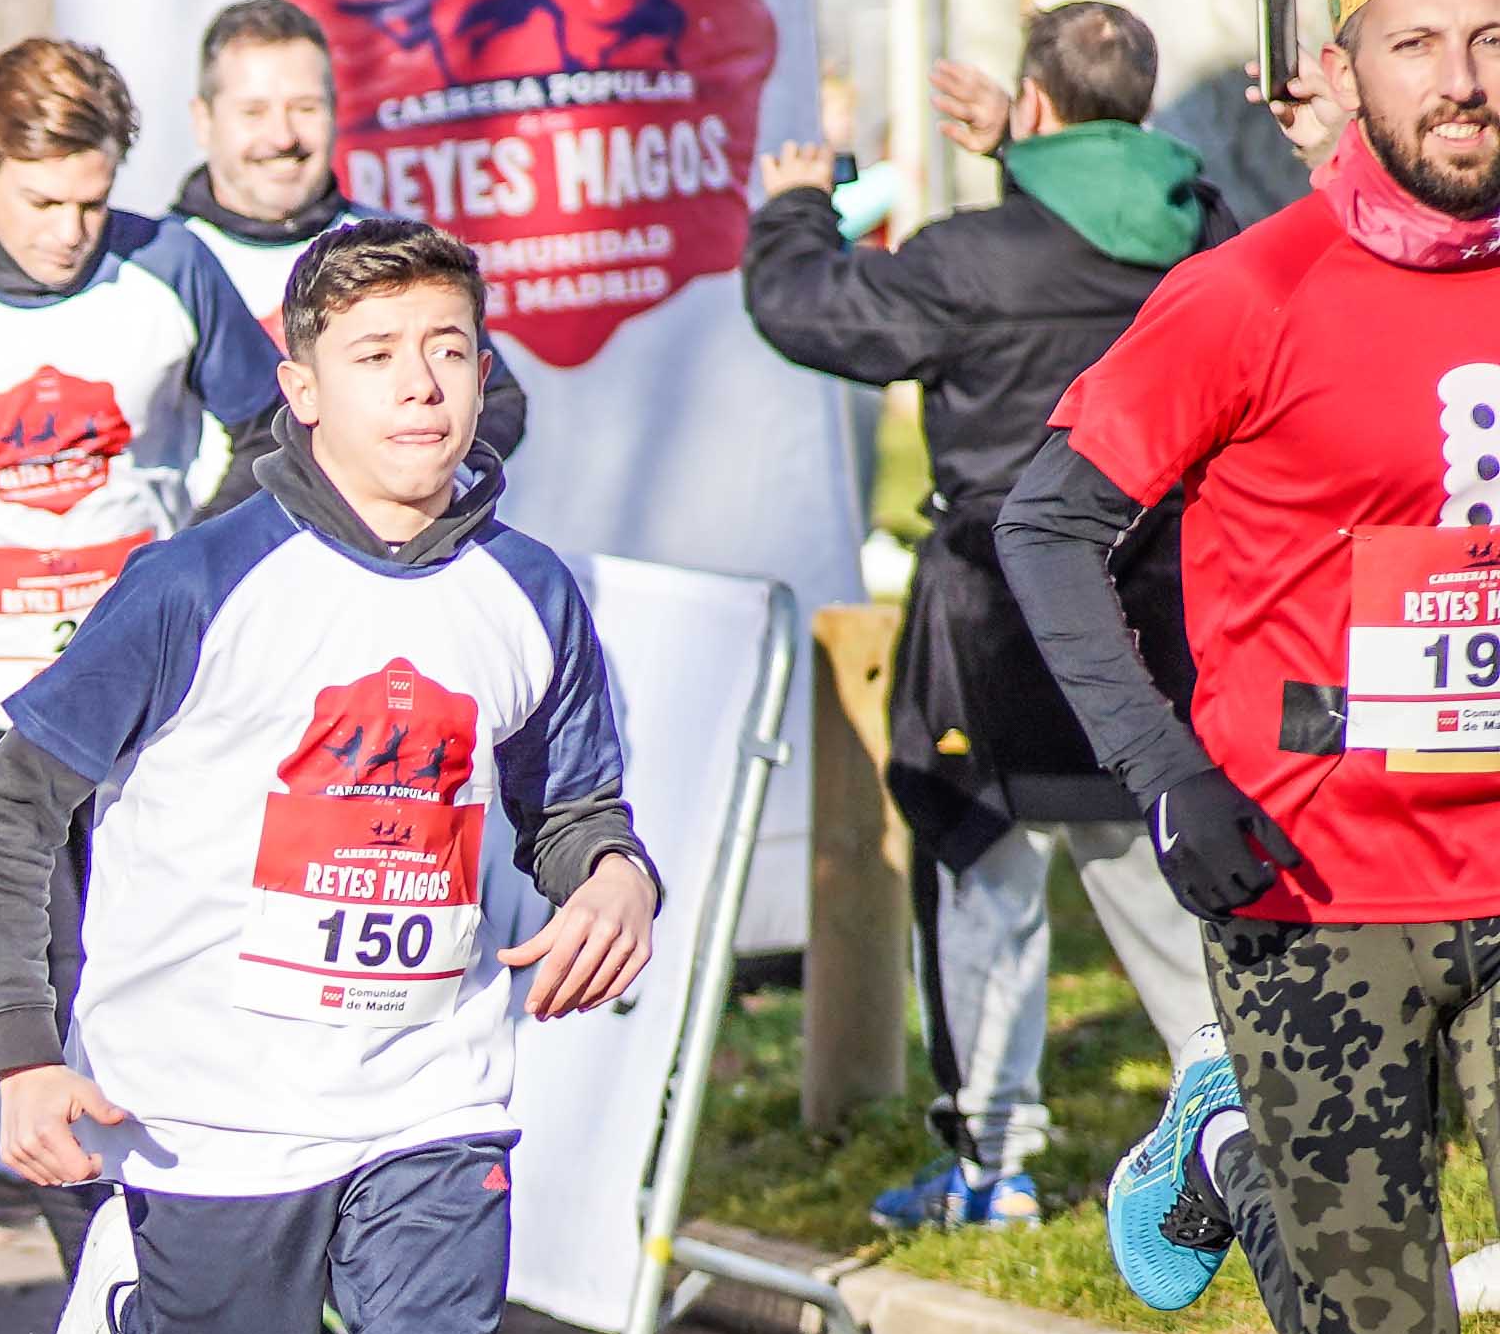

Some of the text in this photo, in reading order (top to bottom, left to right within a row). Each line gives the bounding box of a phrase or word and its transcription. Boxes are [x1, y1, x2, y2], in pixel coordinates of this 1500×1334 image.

[377, 75, 546, 130] CARRERA
[346, 114, 733, 222] REYES MAGOS
[516, 267, 670, 315] MADRID
[1403, 590, 1481, 623] REYES
[1462, 720, 1479, 732] de
[325, 783, 441, 802] CARRERA POPULAR
[333, 848, 438, 865] CARRERA POPULAR
[304, 861, 451, 903] REYES MAGOS
[317, 908, 433, 969] 150
[346, 1000, 405, 1012] de Madrid
[348, 987, 408, 998] Comunidad
